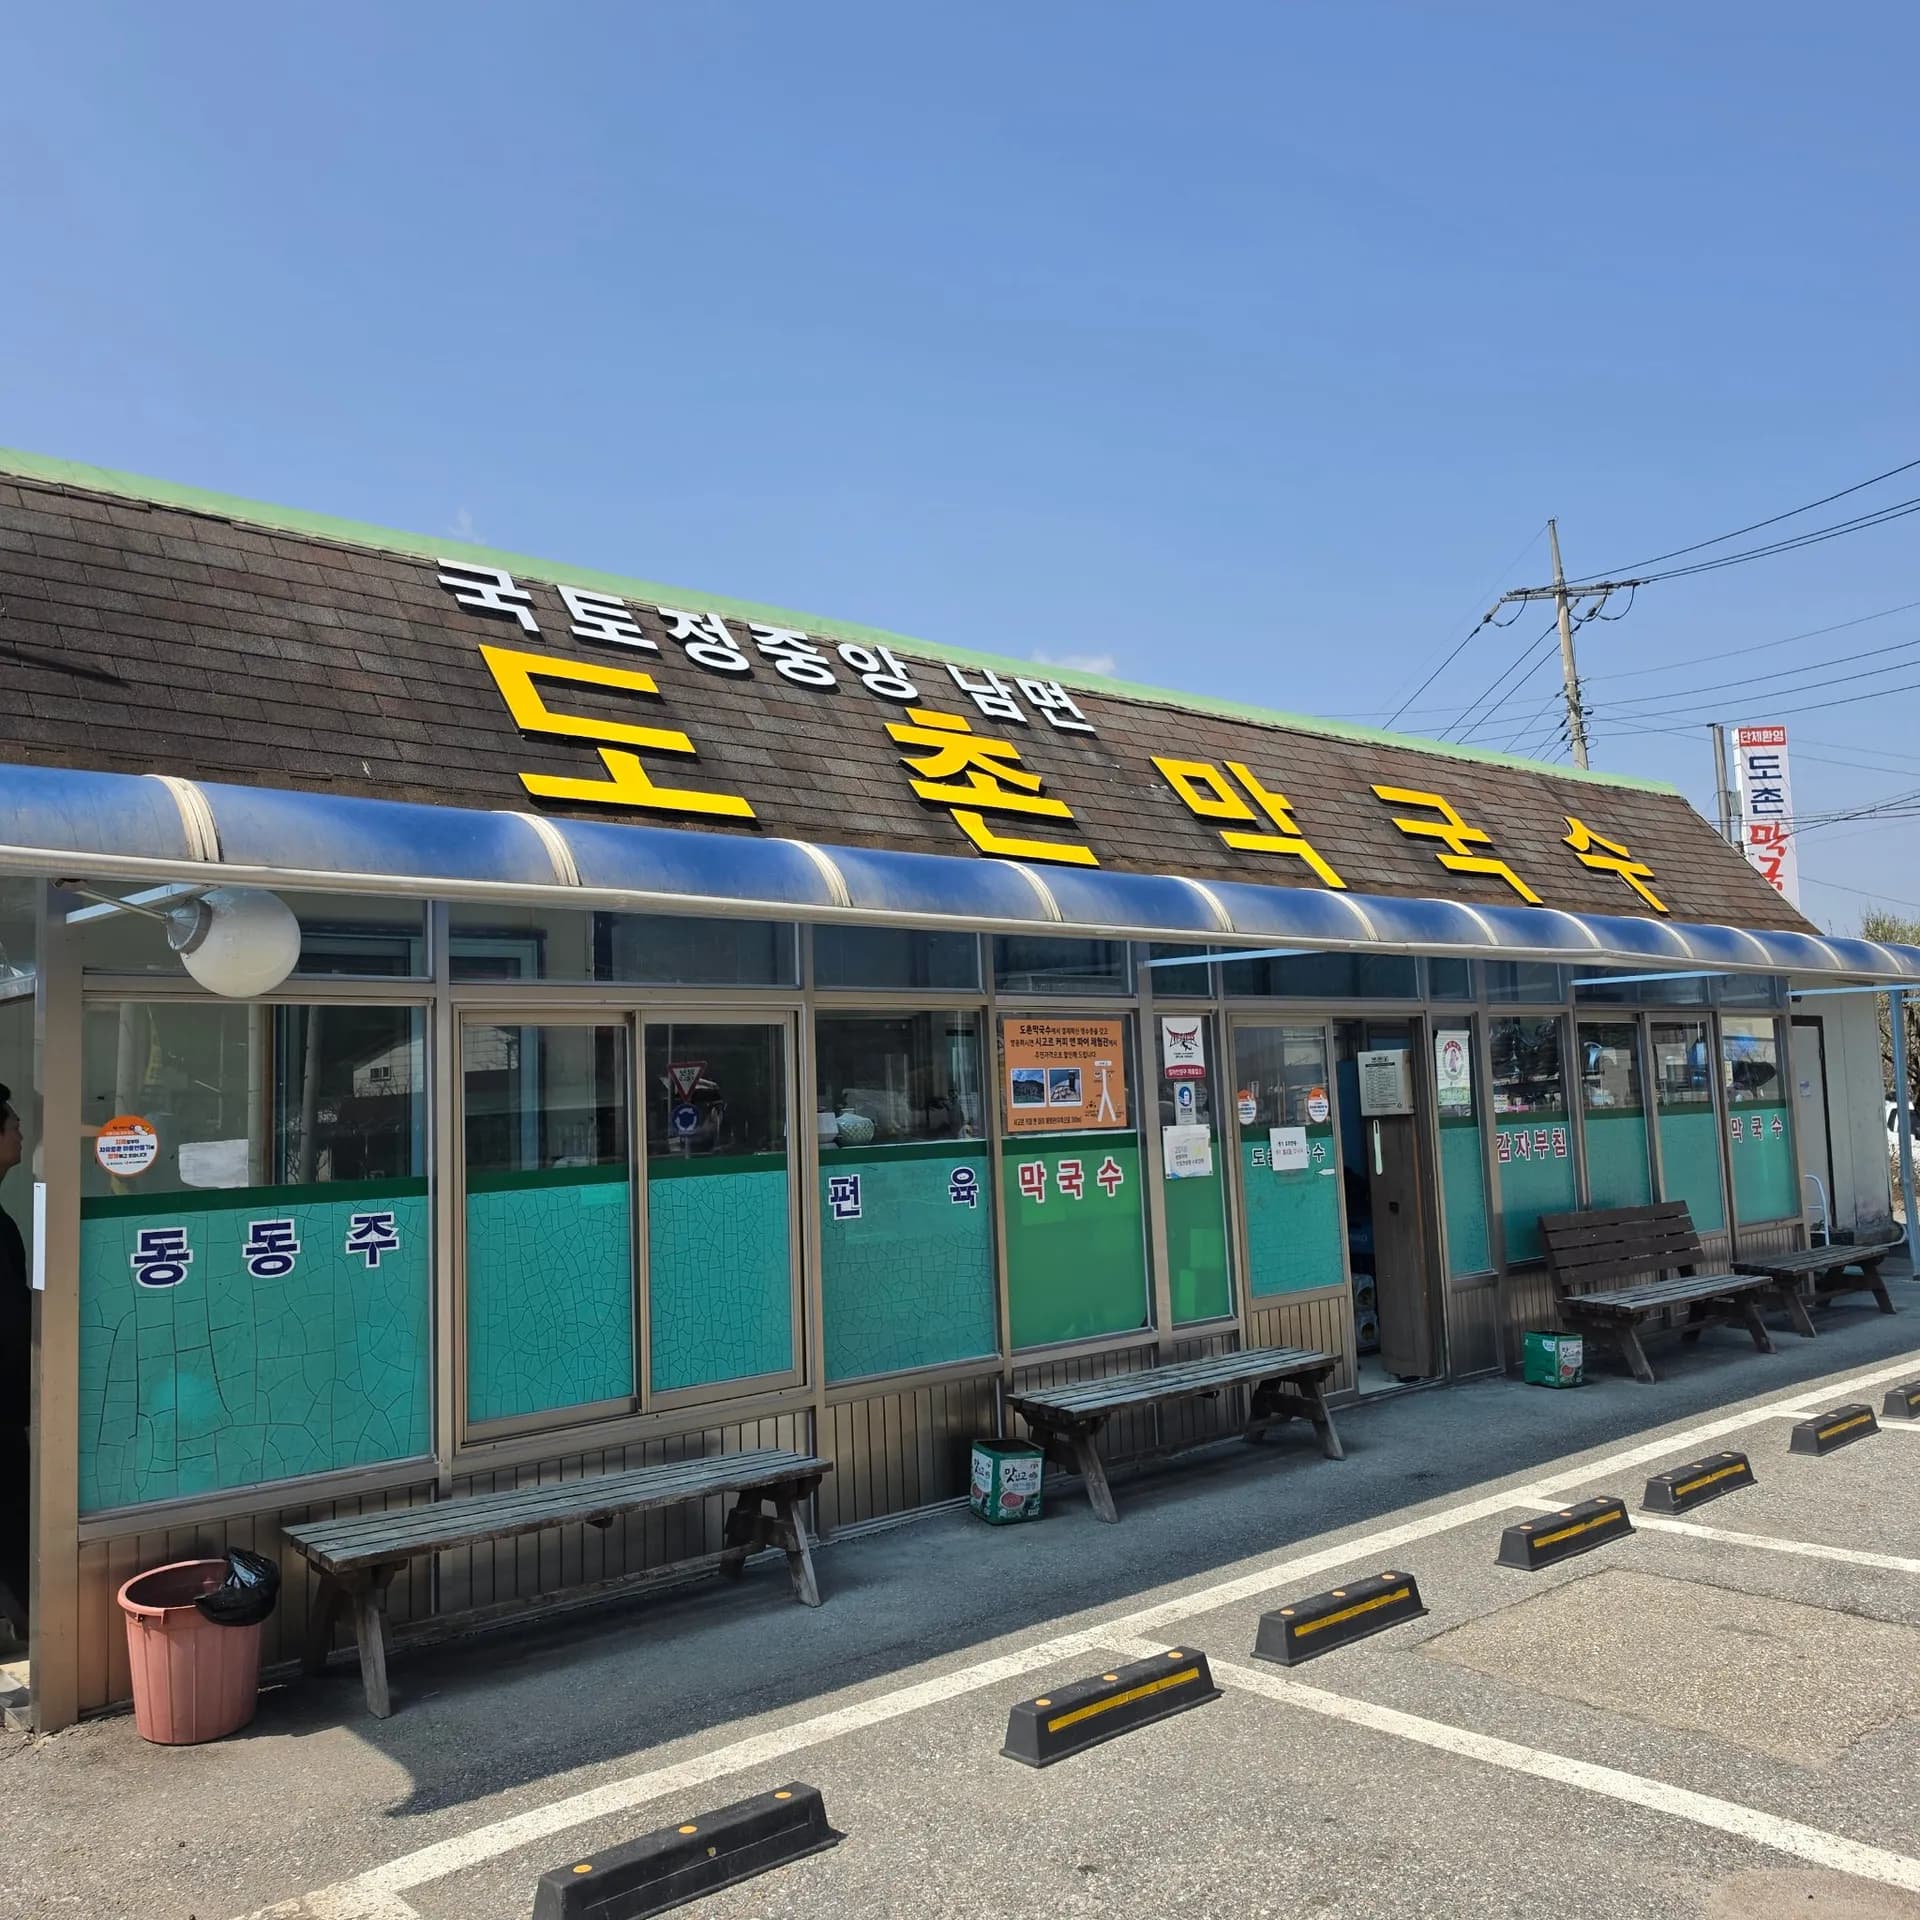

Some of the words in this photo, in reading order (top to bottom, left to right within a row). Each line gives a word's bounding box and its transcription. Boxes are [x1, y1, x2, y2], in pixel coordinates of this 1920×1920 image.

[435, 557, 920, 700] 국토정중앙
[945, 662, 1096, 734] 남면
[1740, 731, 1785, 744] 단체환영
[1496, 1128, 1567, 1163] 감자부침
[1731, 1114, 1783, 1143] 막국수
[1018, 1156, 1124, 1202] 막국수
[130, 1212, 401, 1288] 동동주
